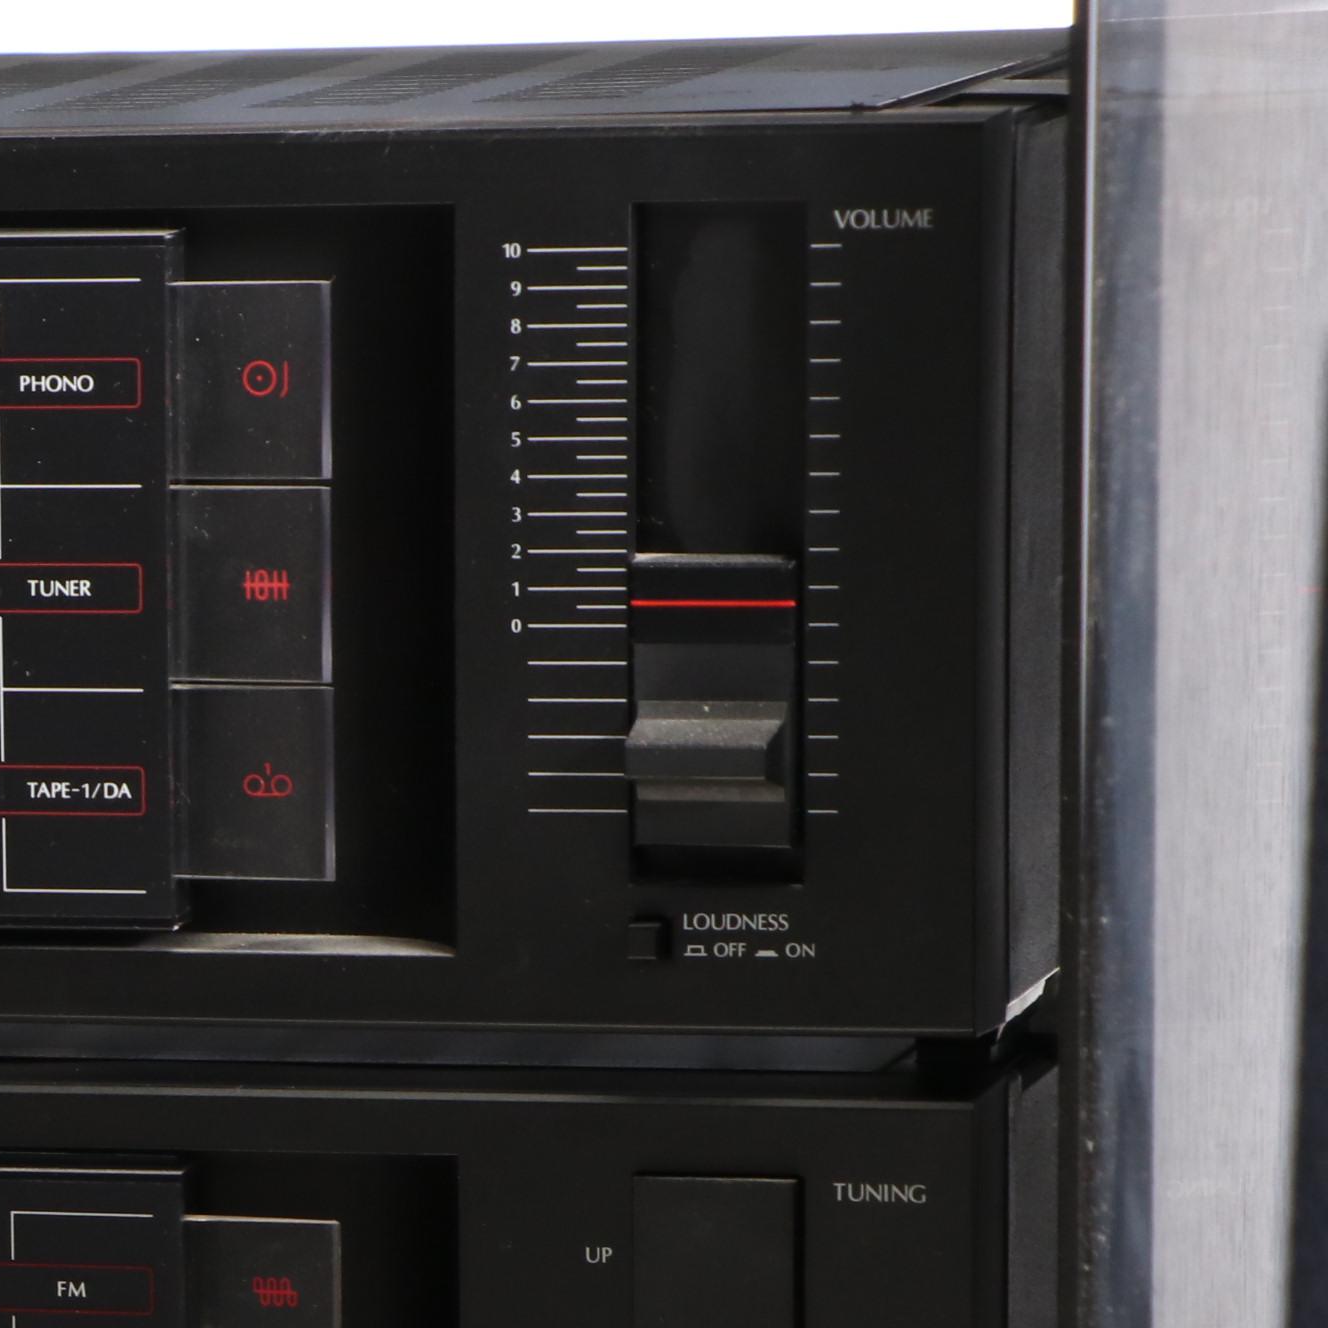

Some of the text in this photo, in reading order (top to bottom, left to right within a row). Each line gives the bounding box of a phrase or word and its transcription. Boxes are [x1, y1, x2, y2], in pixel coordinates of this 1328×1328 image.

[833, 207, 935, 230] VOLUME
[502, 242, 522, 259] 10
[19, 374, 95, 393] PHONO
[27, 579, 92, 598] TUNER
[683, 912, 789, 932] LOUDNESS
[713, 942, 816, 958] OFF ON
[833, 1182, 927, 1204] TUNING
[585, 1246, 613, 1264] UP
[57, 1280, 87, 1298] FM
